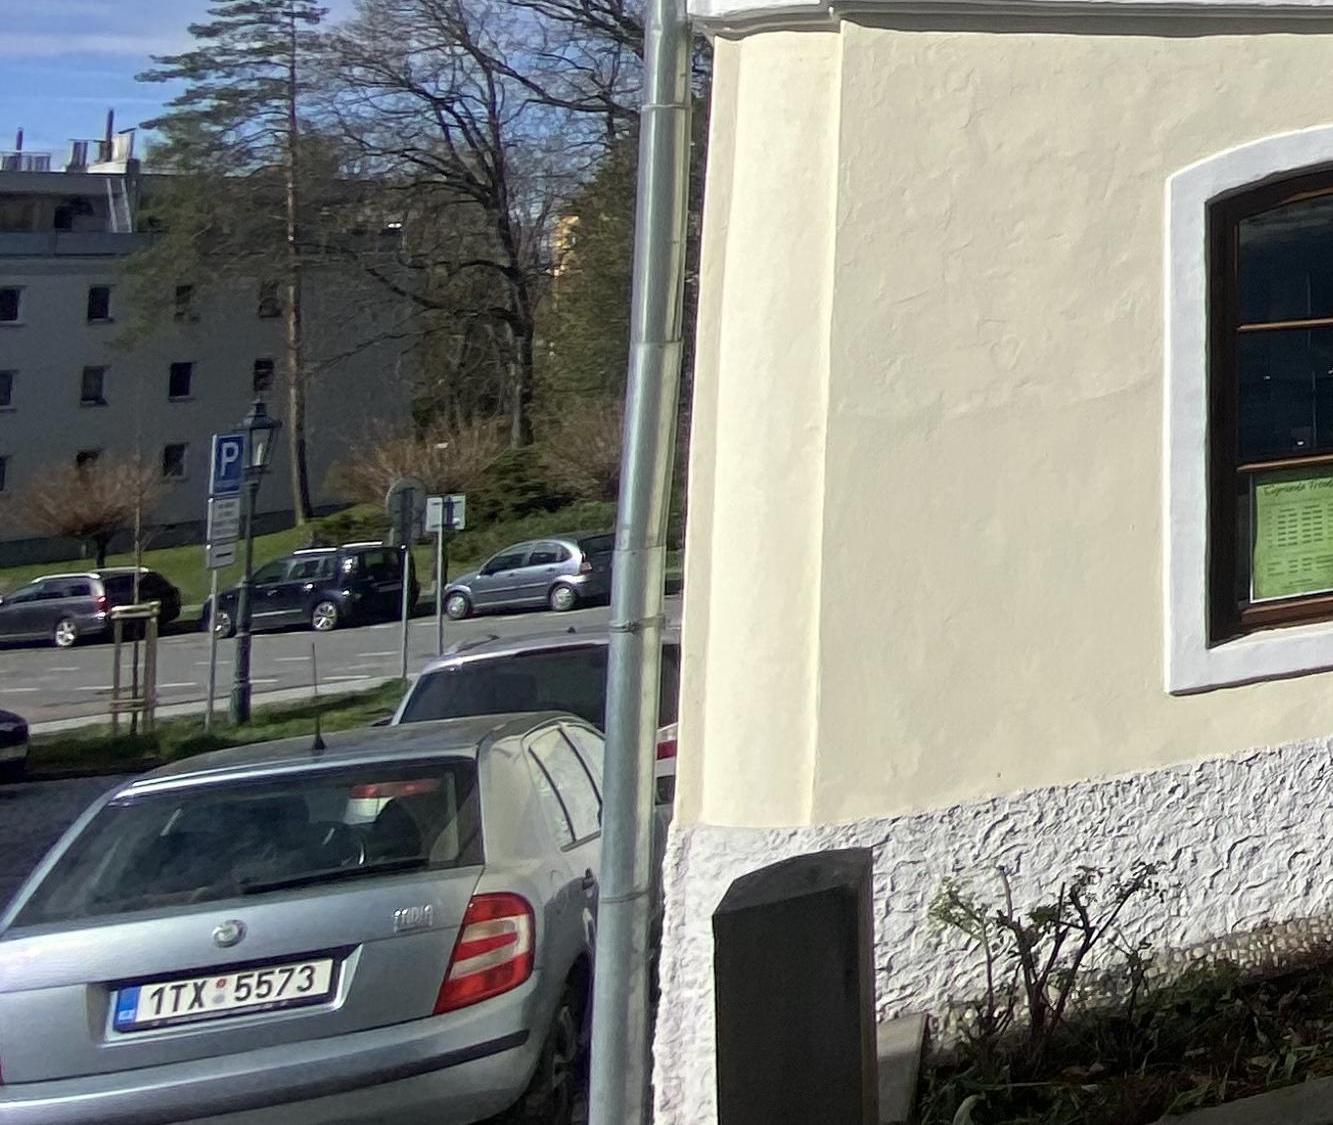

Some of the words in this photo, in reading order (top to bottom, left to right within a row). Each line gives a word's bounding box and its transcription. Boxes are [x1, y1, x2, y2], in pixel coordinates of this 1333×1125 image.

[221, 441, 239, 476] P
[149, 979, 207, 1015] 1TX
[234, 965, 316, 1002] 5573
